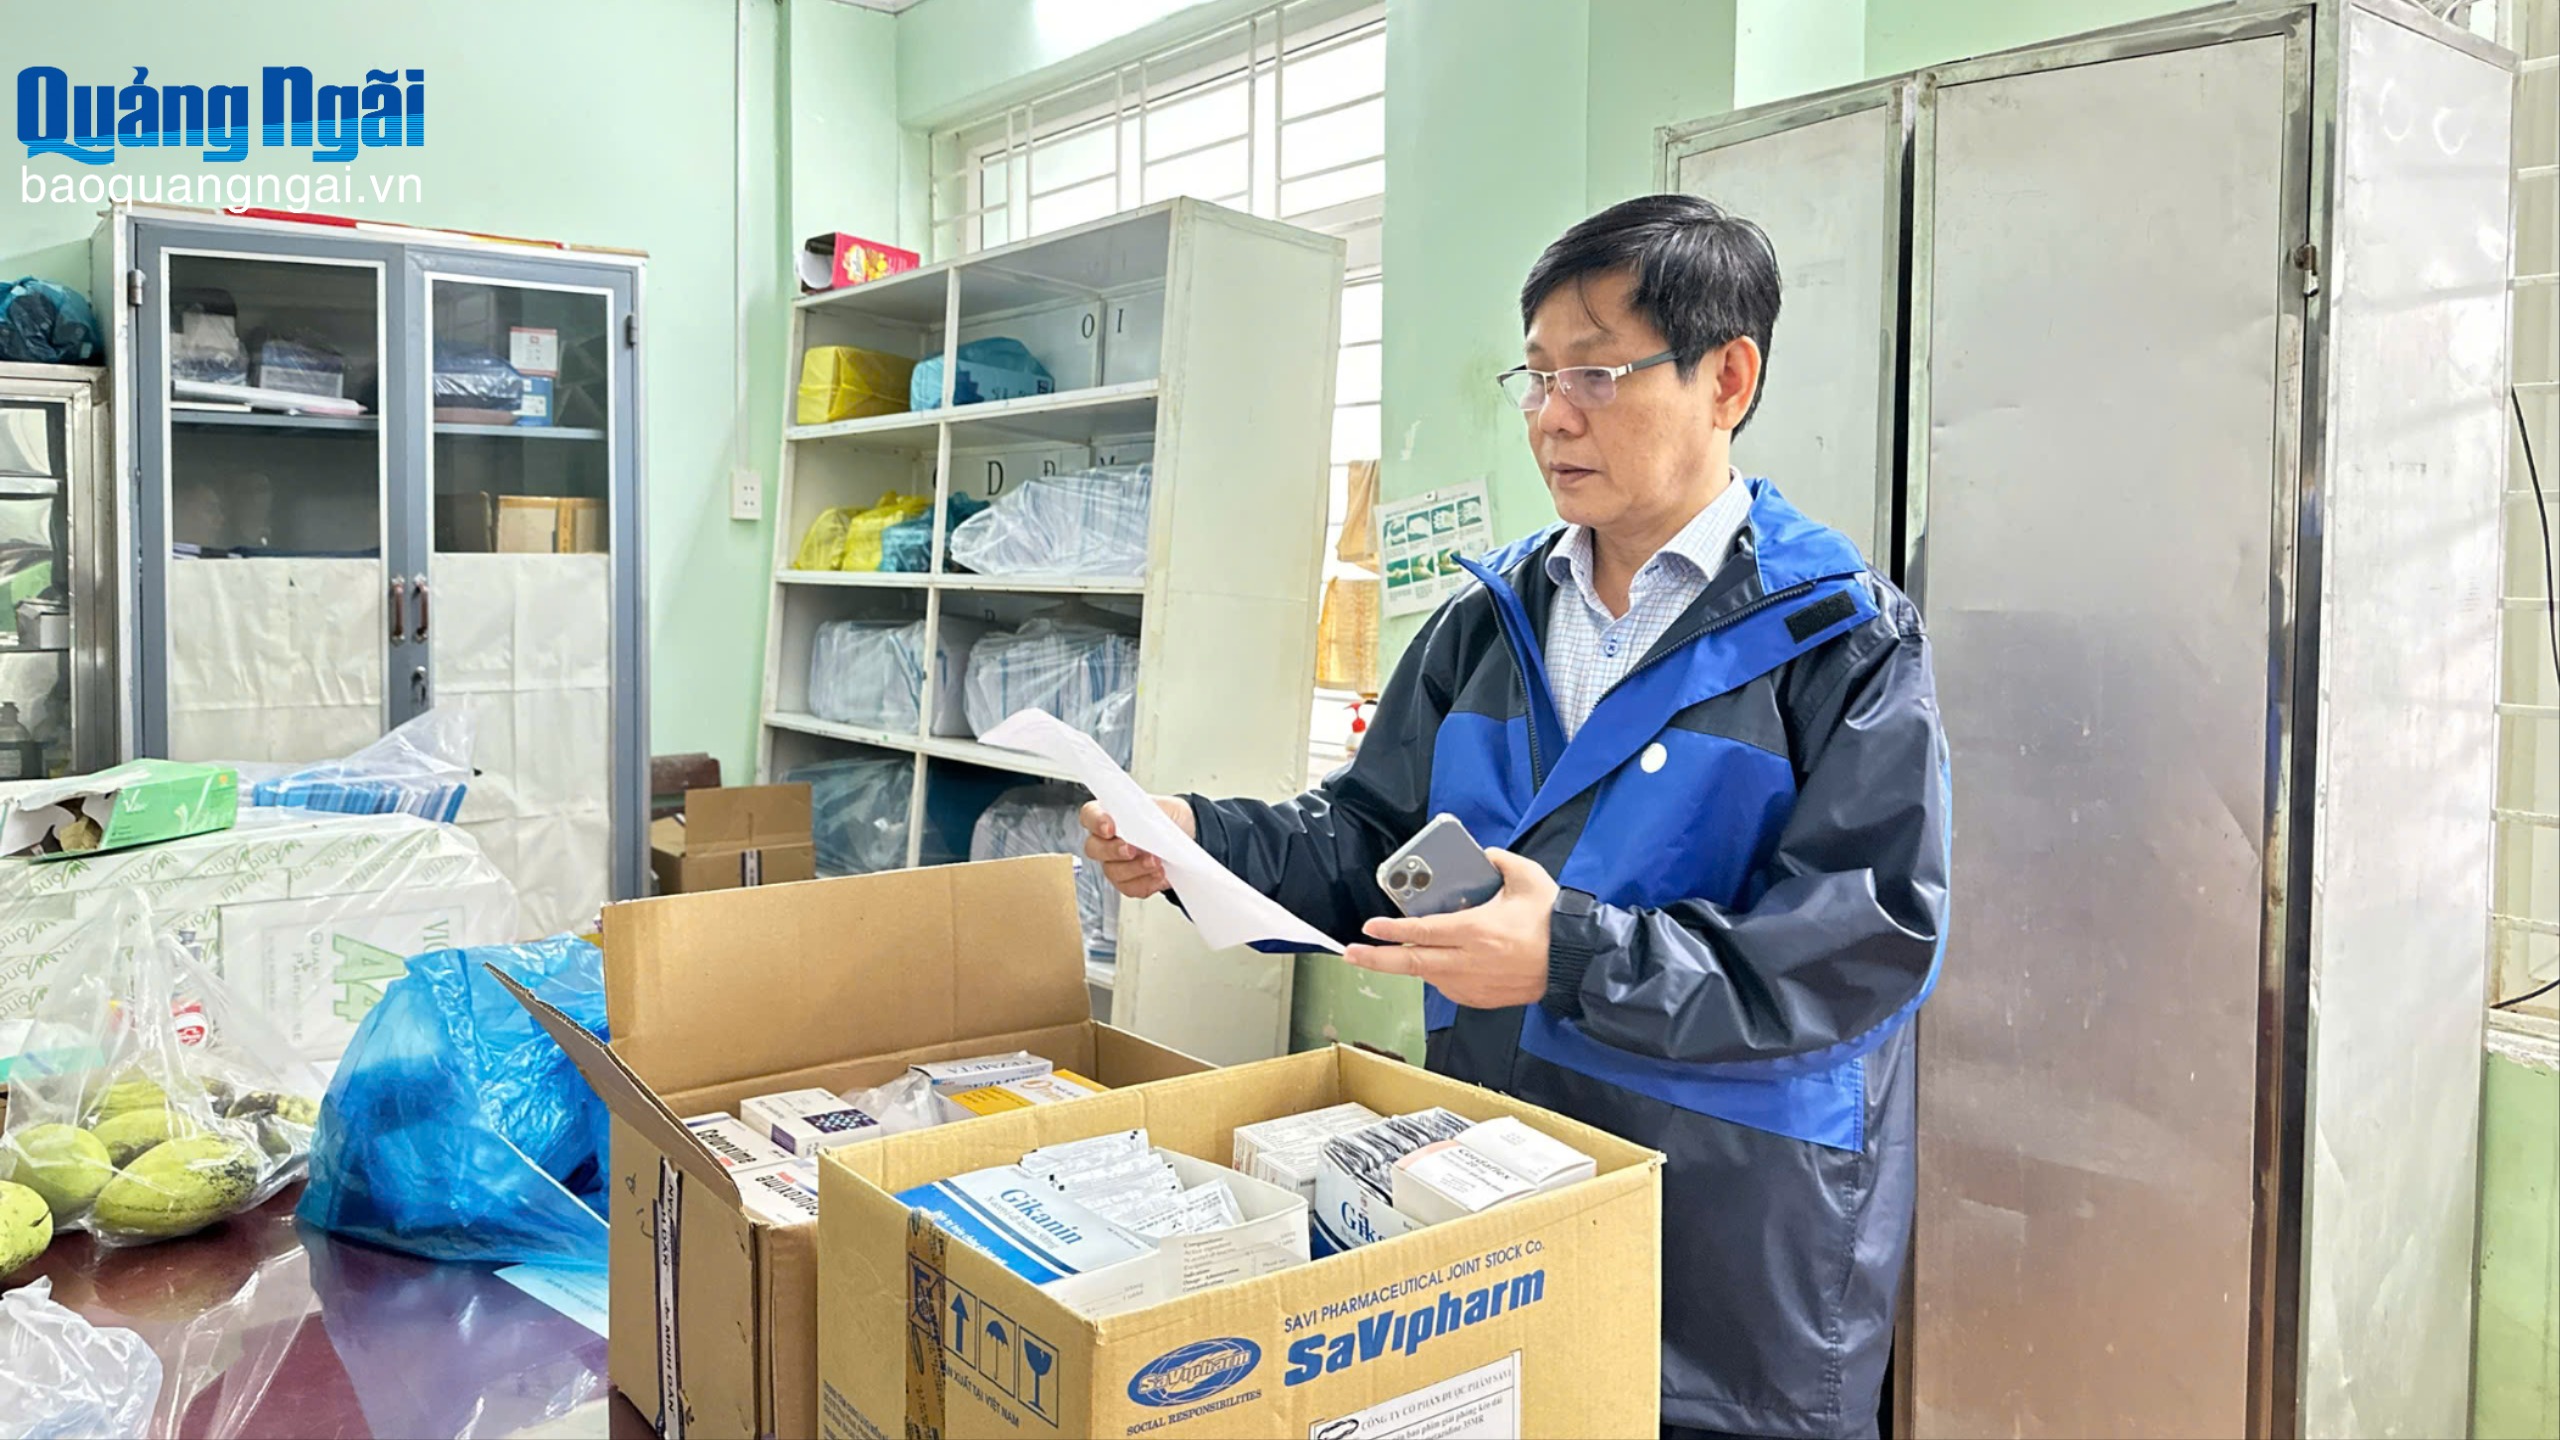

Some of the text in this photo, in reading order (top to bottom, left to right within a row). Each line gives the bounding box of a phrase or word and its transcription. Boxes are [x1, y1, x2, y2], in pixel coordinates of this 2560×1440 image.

[987, 460, 1005, 496] D
[332, 933, 410, 1023] A4
[1000, 1188, 1083, 1246] Gikanin
[1284, 1239, 1545, 1334] SAVI PHARMACEUTICAL JOINT STOCK Co.
[1001, 1407, 1020, 1429] NAM
[1126, 1388, 1263, 1437] SOCIAL RESPONSIBILITIES
[1361, 1413, 1388, 1432] CÔNG
[1389, 1409, 1400, 1421] TY
